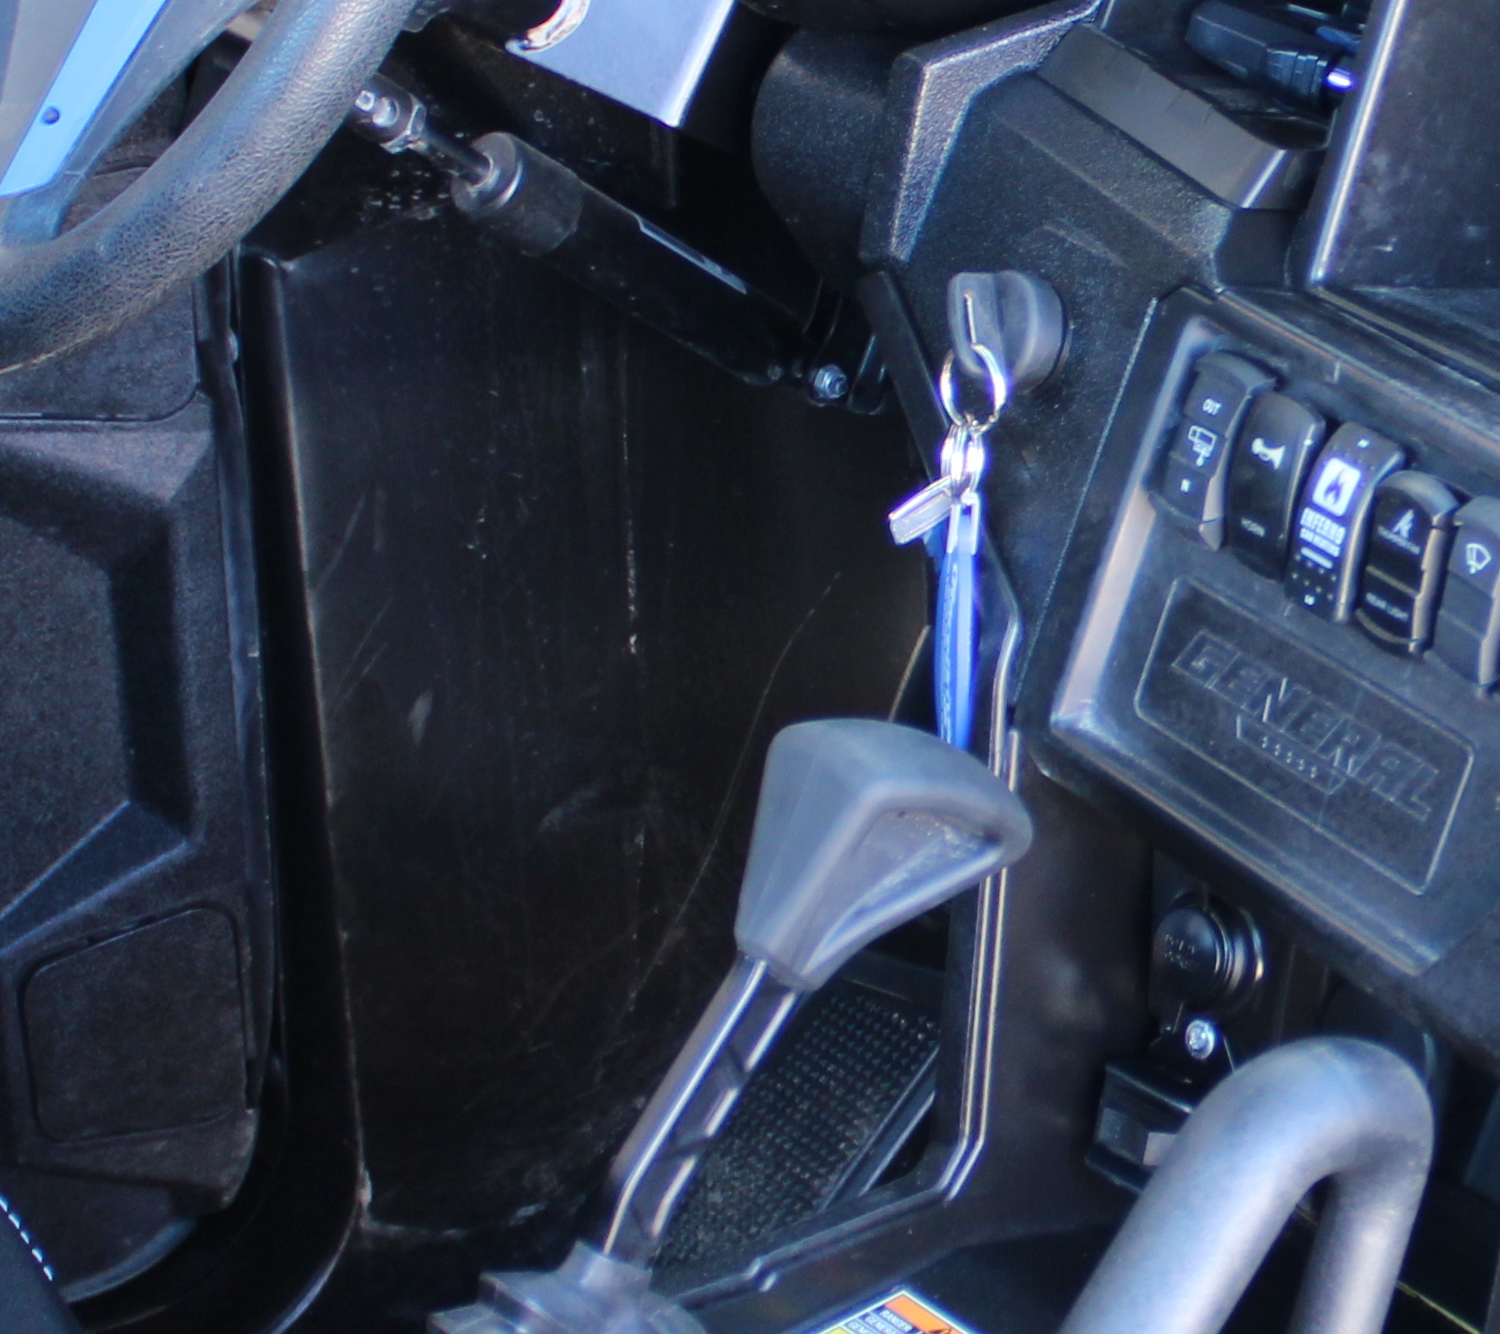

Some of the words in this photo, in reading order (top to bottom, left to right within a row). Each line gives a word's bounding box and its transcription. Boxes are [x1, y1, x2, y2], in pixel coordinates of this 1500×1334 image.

[1202, 398, 1223, 416] OUT
[1299, 506, 1347, 545] INFERNO
[1170, 628, 1441, 824] GENERAL
